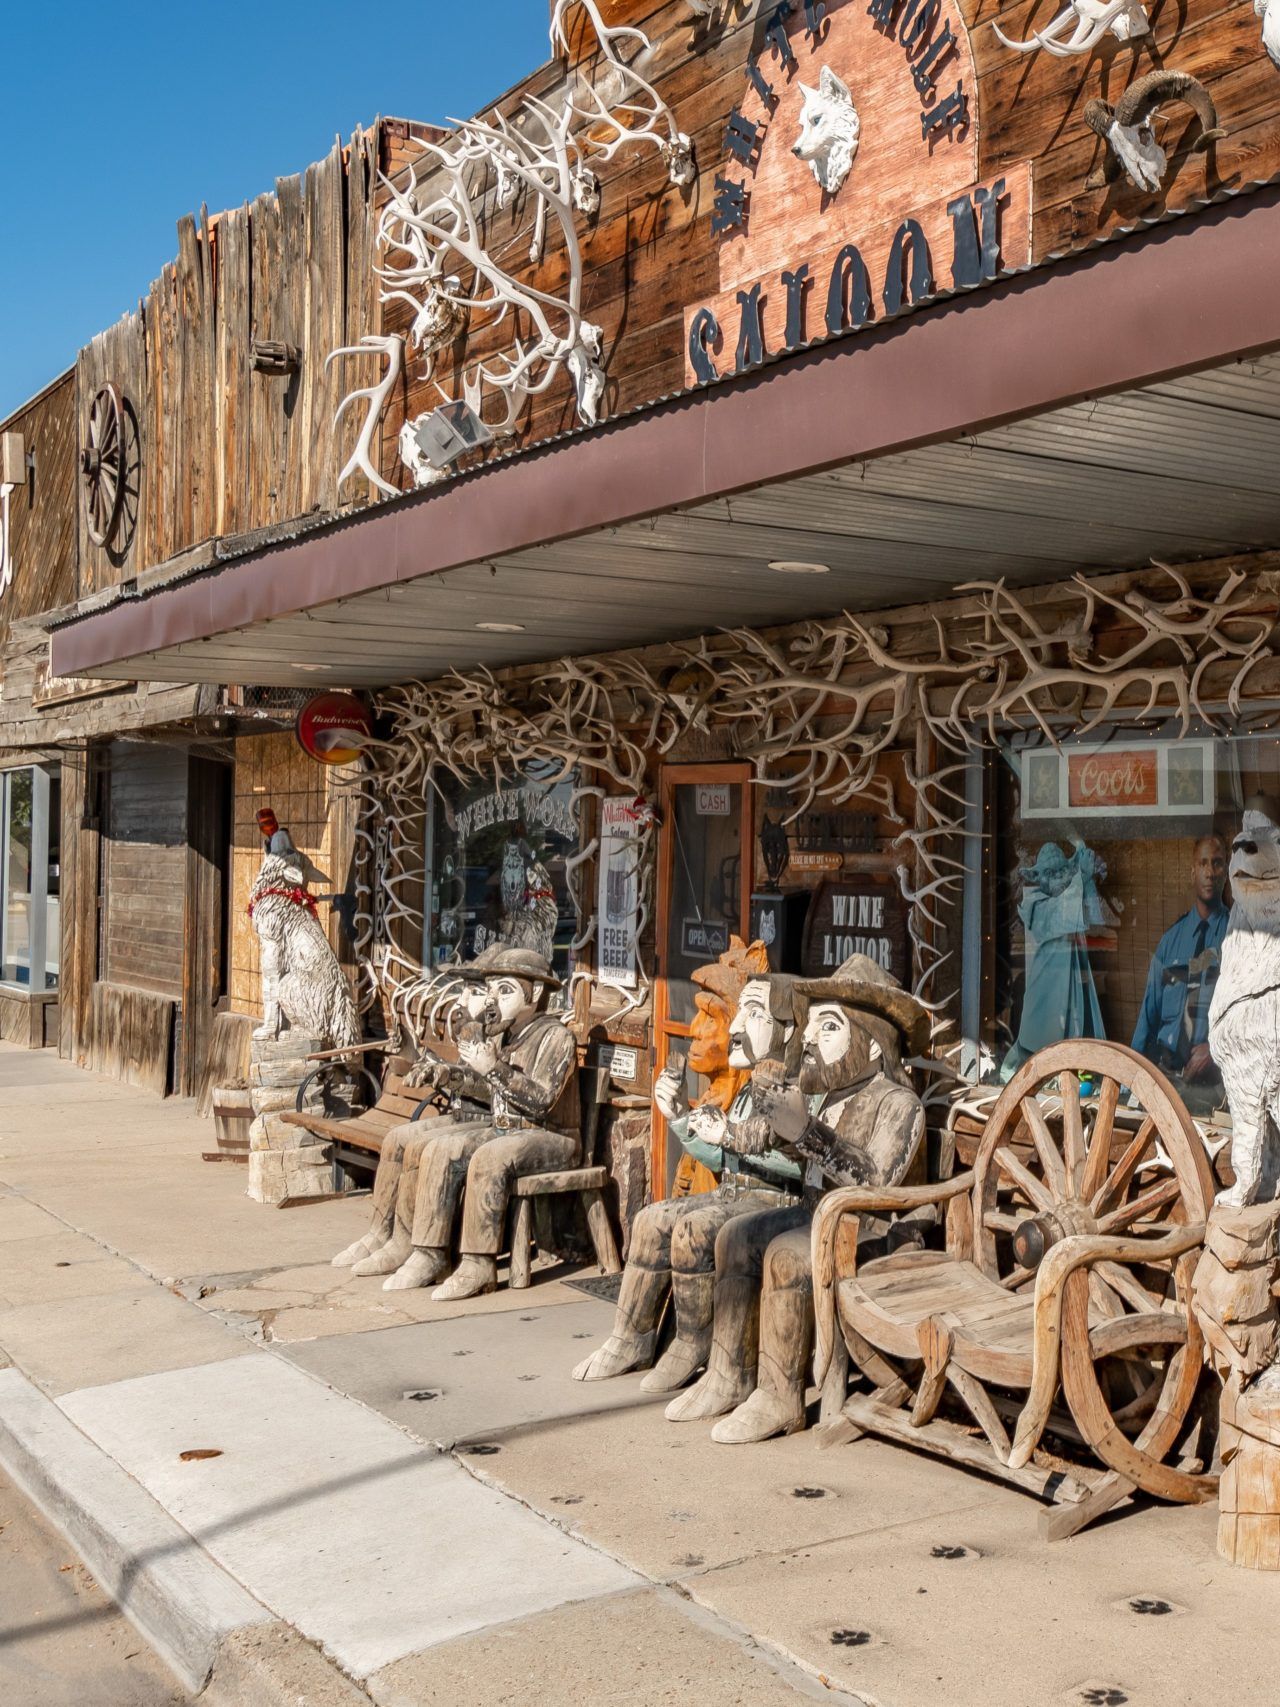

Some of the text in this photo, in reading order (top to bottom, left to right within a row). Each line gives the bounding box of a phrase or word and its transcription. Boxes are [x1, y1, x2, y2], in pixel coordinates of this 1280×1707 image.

[1077, 759, 1147, 798] Coors
[700, 791, 726, 811] CASH
[455, 788, 577, 842] WHITE WOLF
[832, 895, 884, 929] WINE
[603, 928, 628, 948] FREE
[603, 949, 629, 968] BEER
